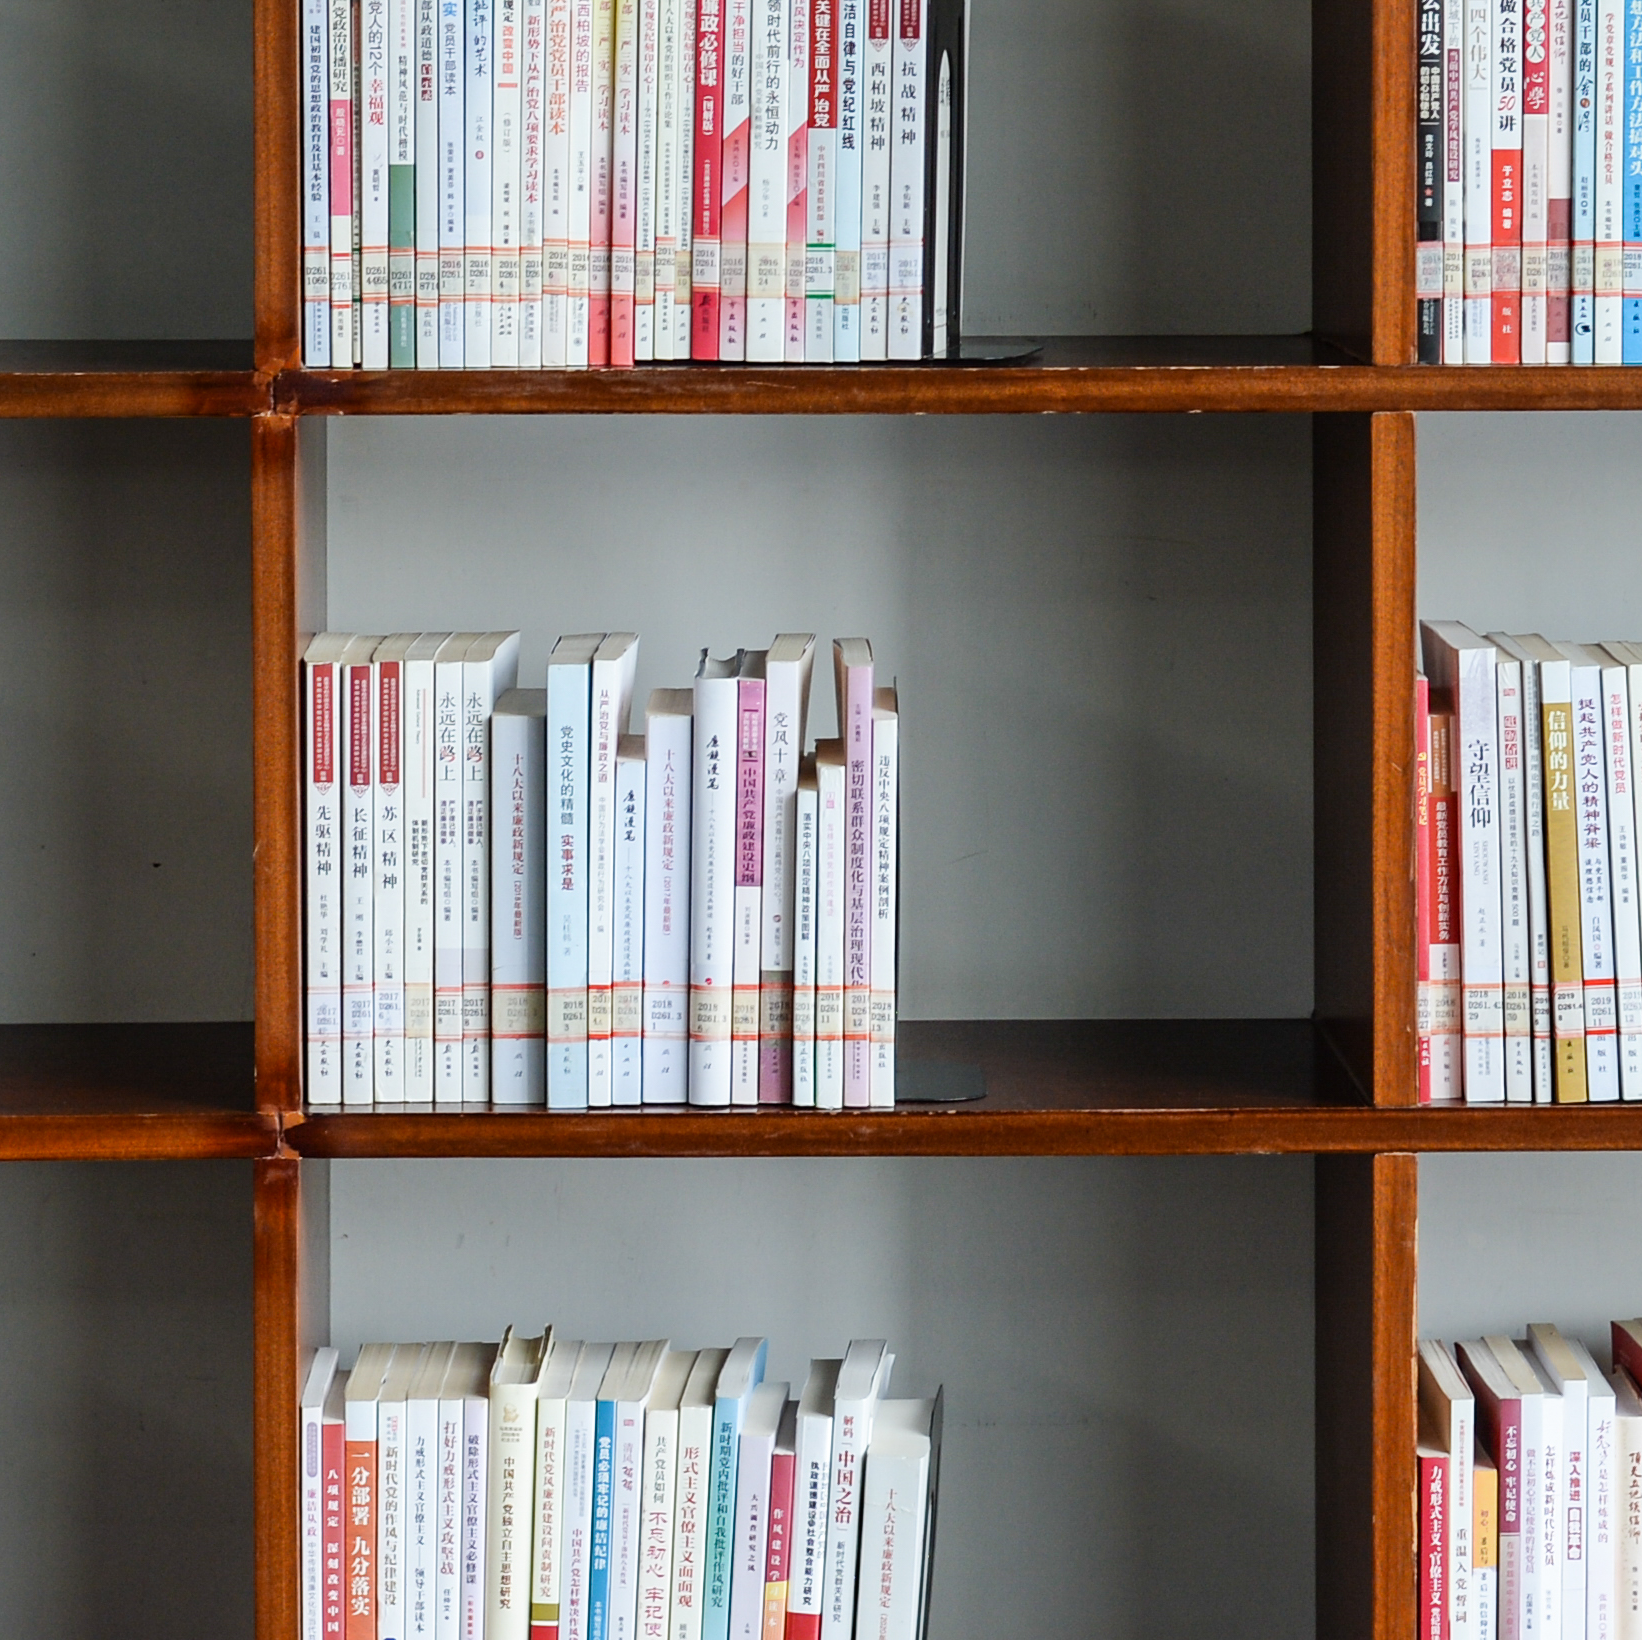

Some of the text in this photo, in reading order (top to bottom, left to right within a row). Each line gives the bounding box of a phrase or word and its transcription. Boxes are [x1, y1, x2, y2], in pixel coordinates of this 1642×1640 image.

[871, 63, 885, 151] 西柏坡精神
[901, 62, 917, 145] 抗战精神
[1468, 740, 1491, 828] 守望信仰
[1547, 709, 1571, 810] 信仰的力量
[351, 1450, 371, 1616] 一分部署 九分落实
